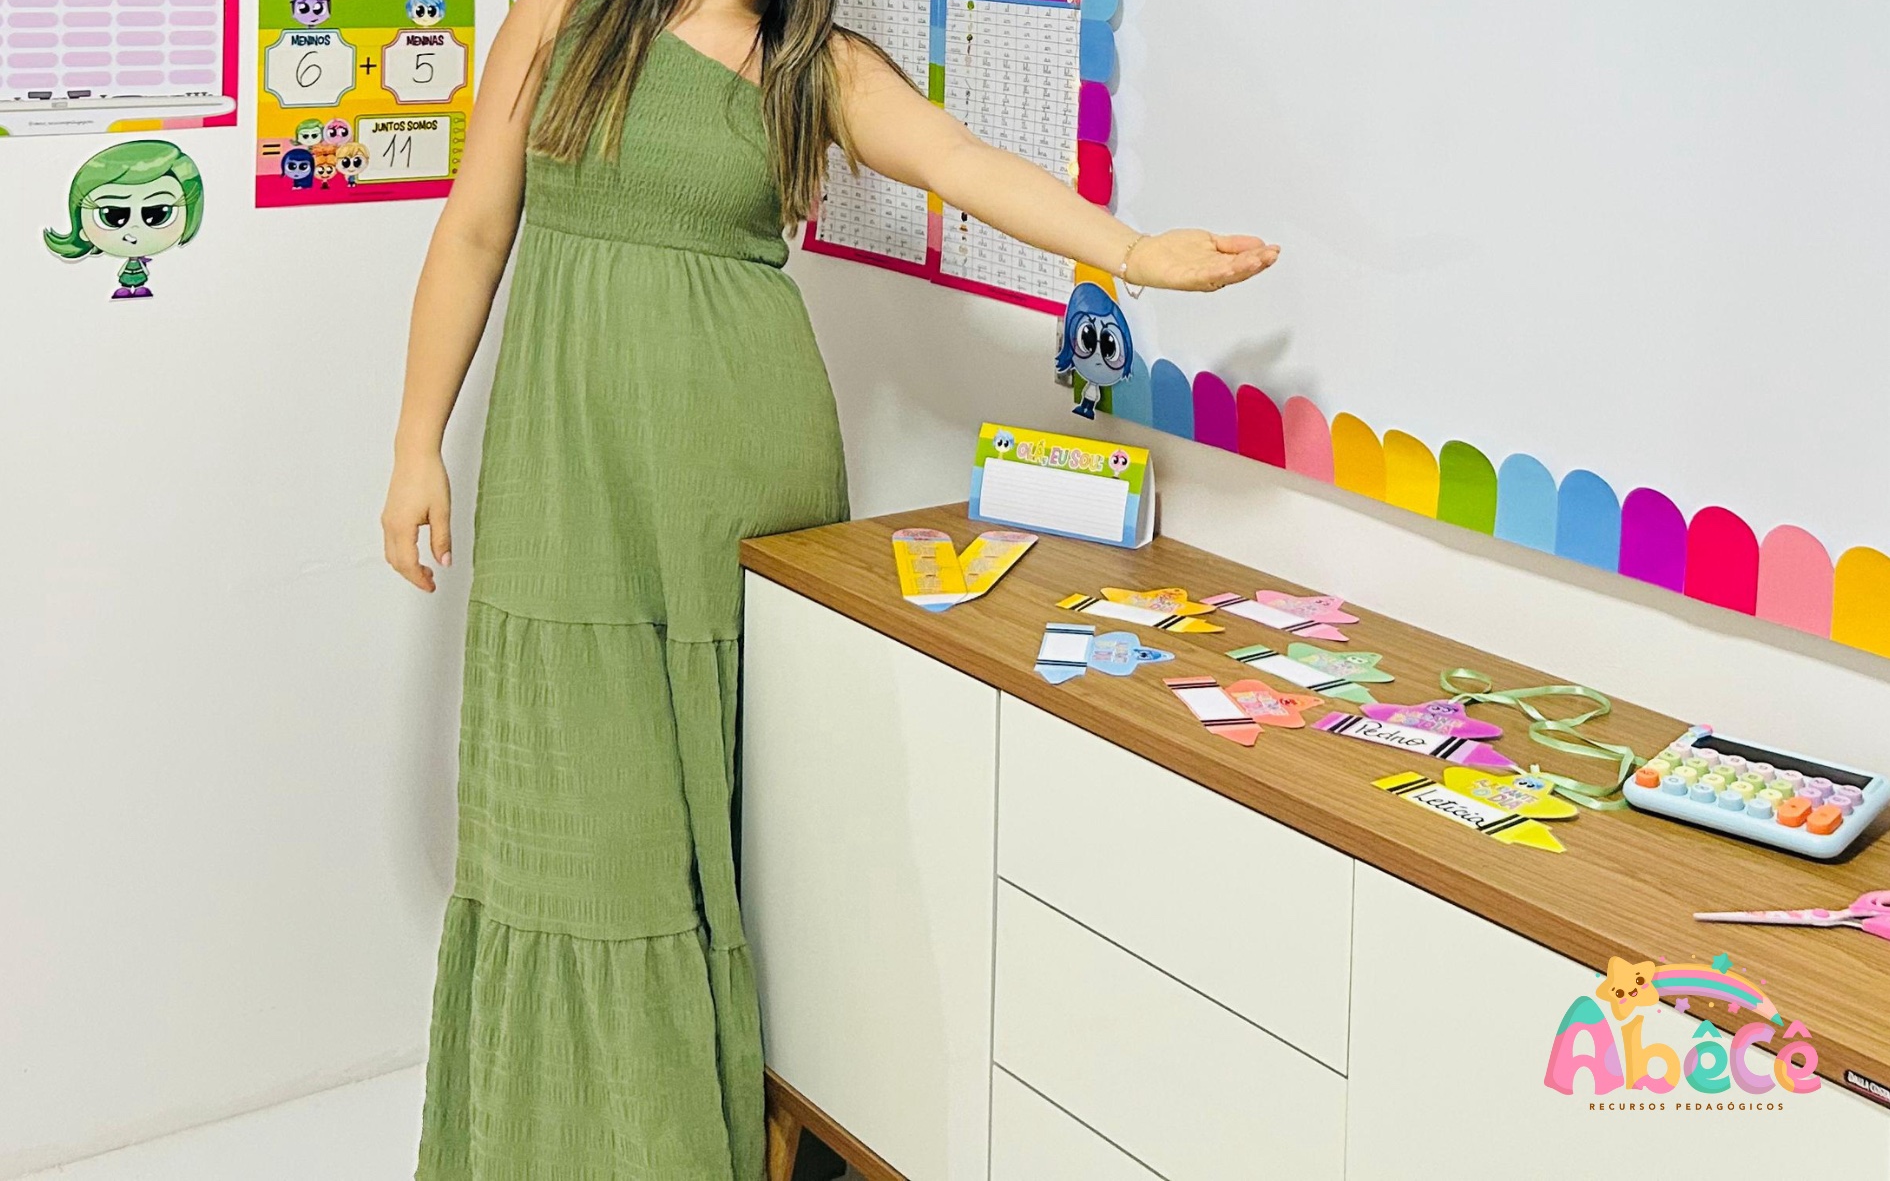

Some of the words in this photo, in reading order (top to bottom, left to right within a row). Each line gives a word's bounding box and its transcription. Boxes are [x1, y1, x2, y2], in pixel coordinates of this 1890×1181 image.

[291, 35, 331, 46] MENINOS
[407, 35, 444, 46] MENINAS
[296, 51, 322, 87] 6
[412, 53, 436, 83] 5
[372, 121, 406, 133] JUNTOS
[407, 120, 438, 131] SOMOS
[383, 134, 412, 168] 11
[1049, 446, 1068, 465] EU
[1355, 721, 1427, 746] Pedro
